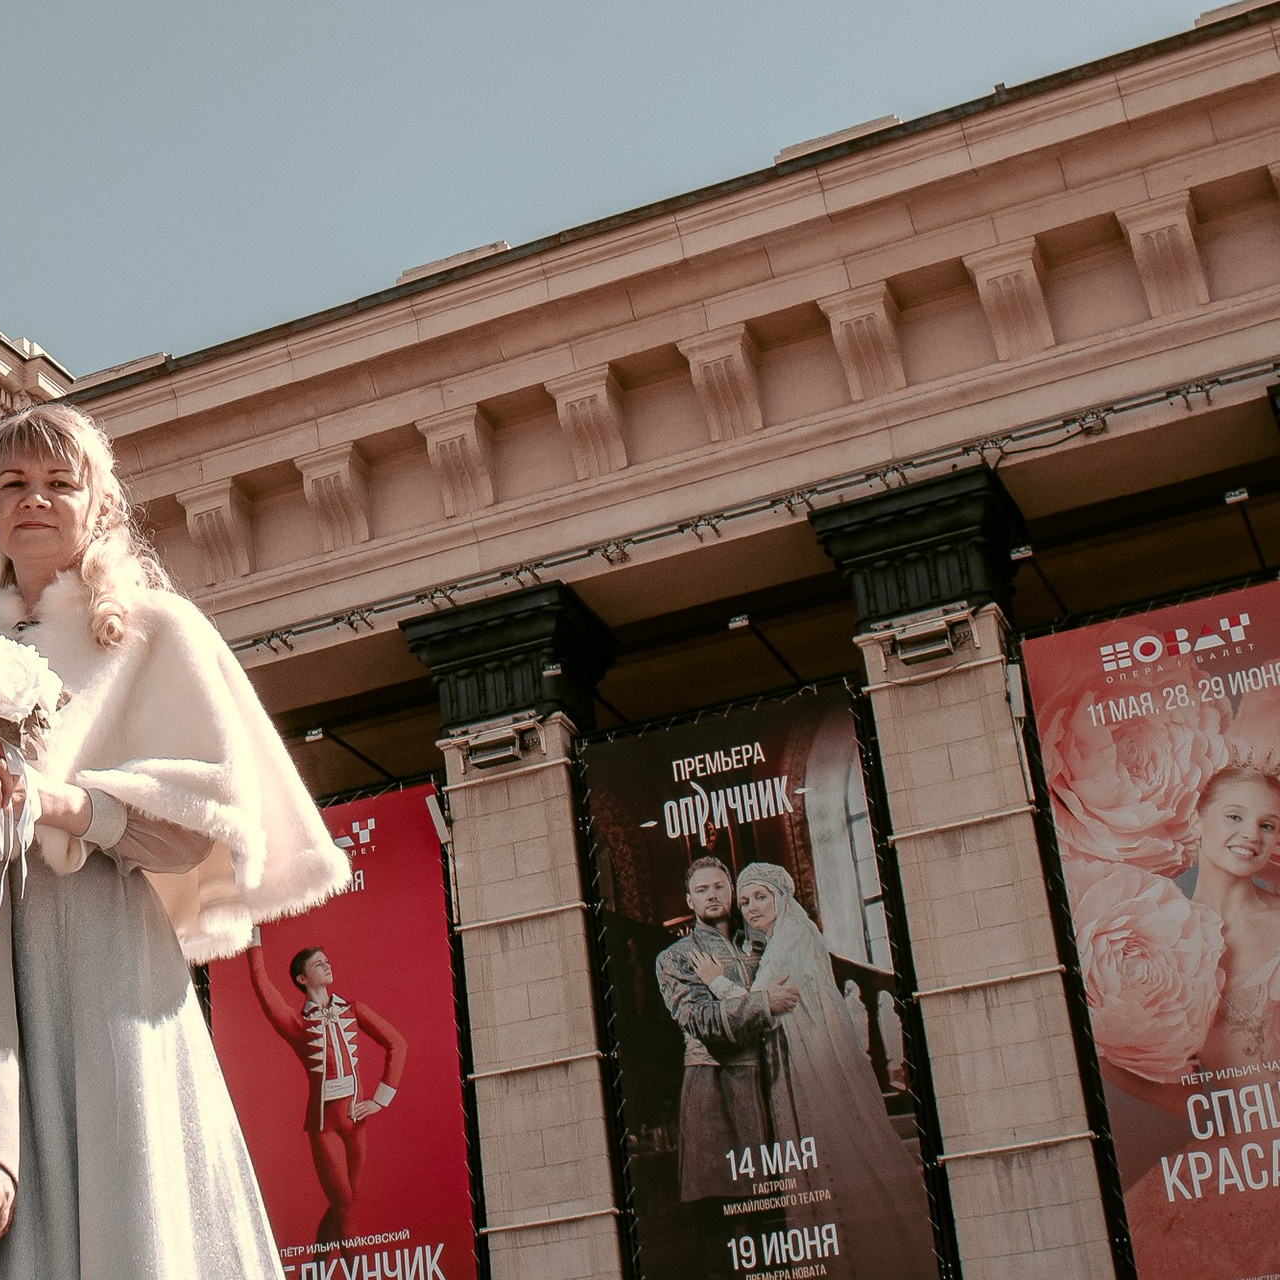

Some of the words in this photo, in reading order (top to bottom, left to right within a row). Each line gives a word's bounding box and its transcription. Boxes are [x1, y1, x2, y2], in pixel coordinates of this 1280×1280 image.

[1105, 665, 1165, 684] ОПЕРА
[1196, 643, 1256, 664] БАЛЕТ
[1086, 702, 1106, 727] 11
[1108, 691, 1160, 723] МАЯ,
[1162, 684, 1196, 711] 28,
[1198, 676, 1225, 703] 29
[671, 741, 767, 782] ПРЕМЬЕРА
[663, 775, 794, 847] ОПРИЧНИК
[1216, 1063, 1261, 1080] ИЛЬИЧ
[1262, 1060, 1280, 1071] ЧА
[725, 1146, 756, 1181] 14
[760, 1136, 819, 1177] МАЯ
[723, 1194, 797, 1216] МИХАЙЛОВСКОГО
[798, 1188, 832, 1205] ТЕАТРА
[752, 1178, 798, 1195] ГАСТРОЛИ
[306, 1240, 340, 1255] ИЛЬИЧ
[341, 1228, 410, 1249] ЧАЙКОВСКИЙ
[727, 1235, 757, 1270] 19
[761, 1223, 840, 1266] ИЮНЯ
[792, 1263, 827, 1280] НОВАТА
